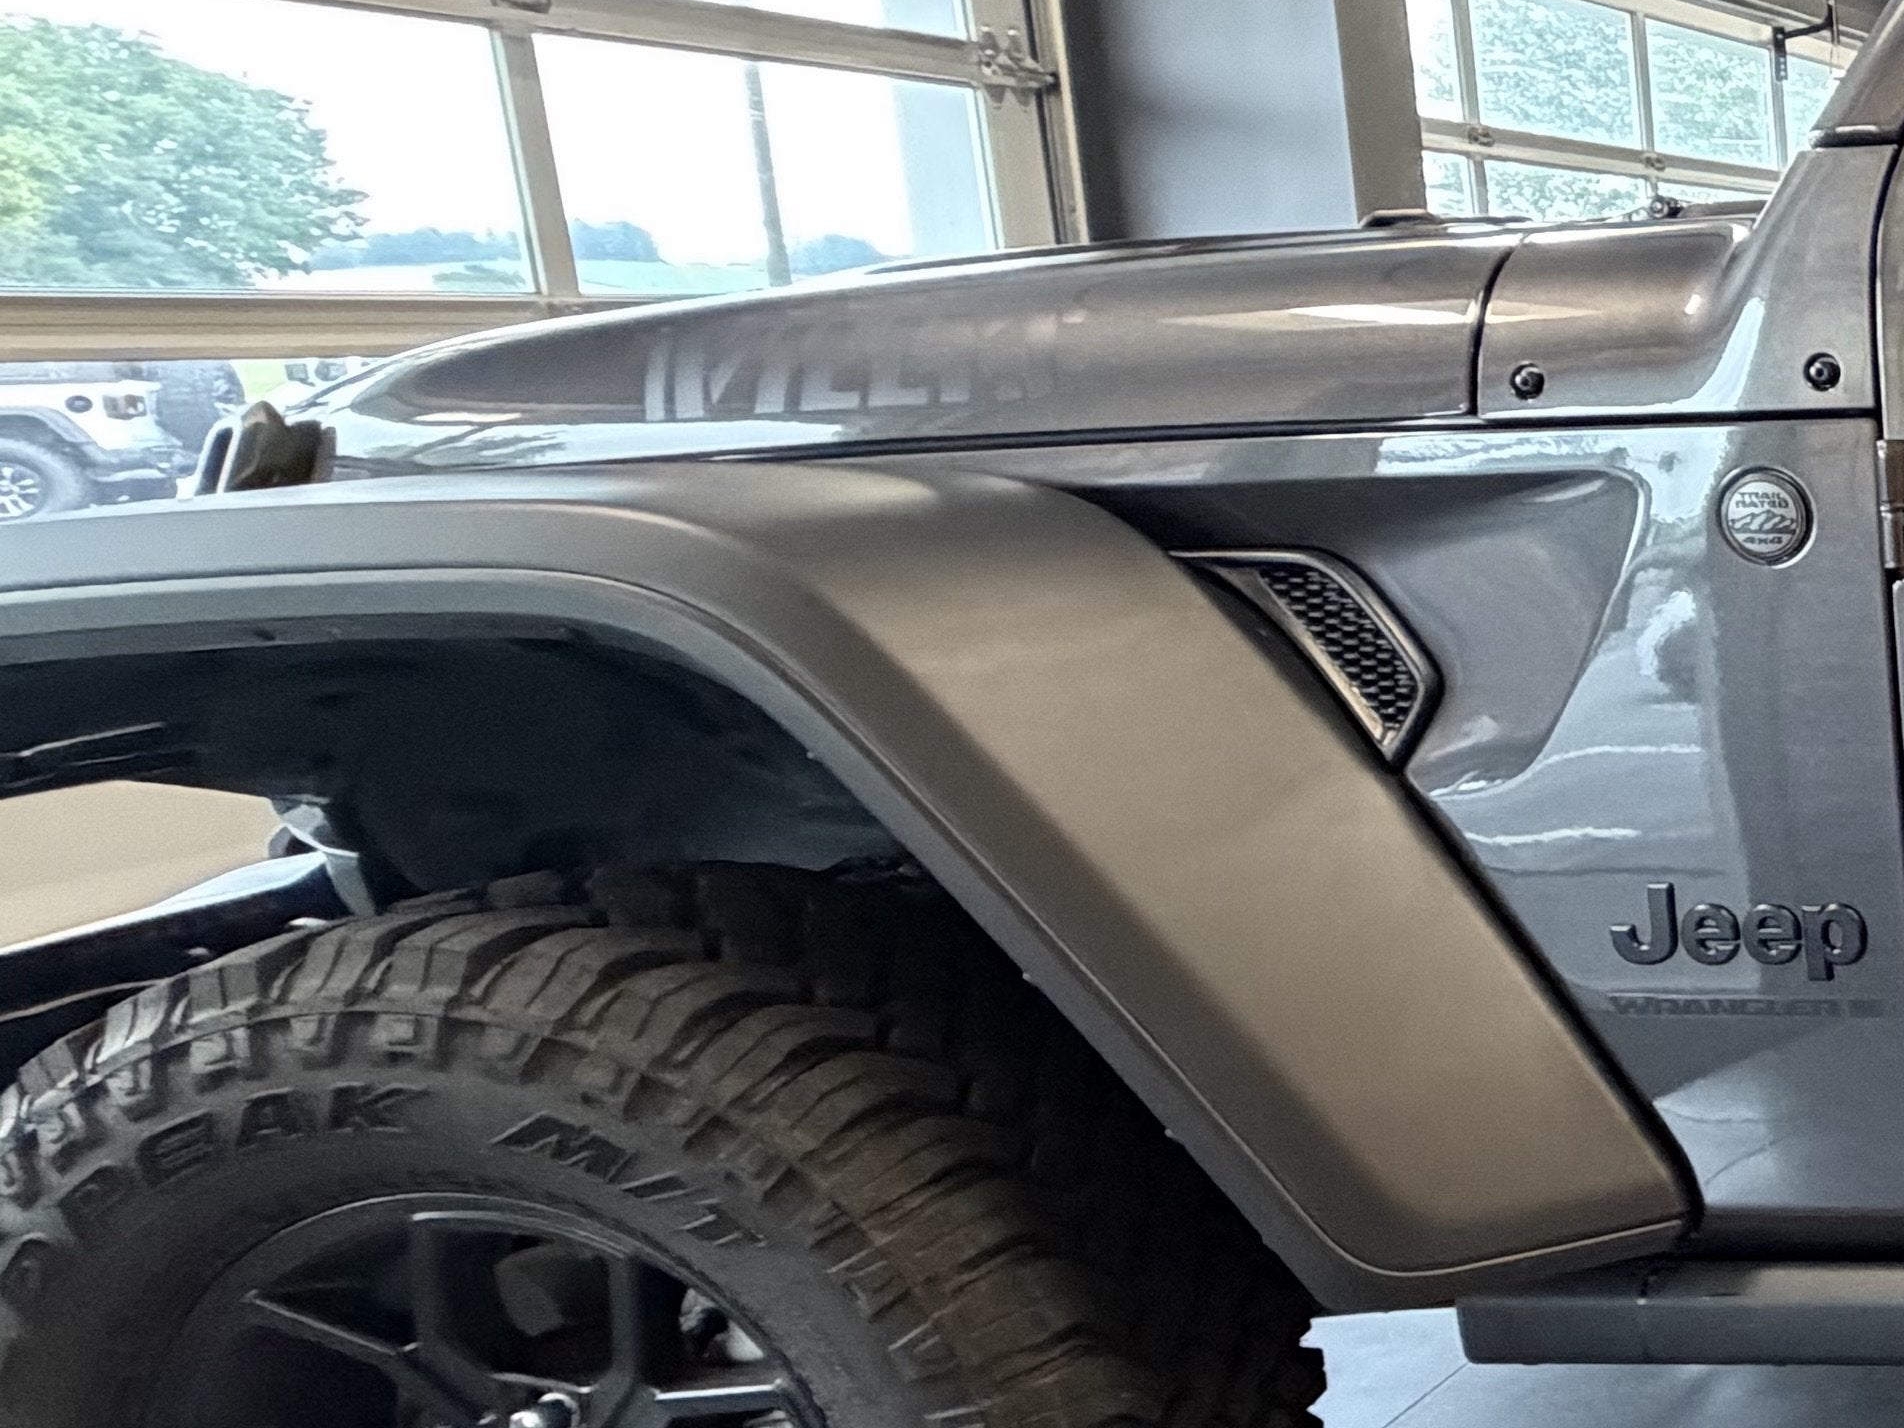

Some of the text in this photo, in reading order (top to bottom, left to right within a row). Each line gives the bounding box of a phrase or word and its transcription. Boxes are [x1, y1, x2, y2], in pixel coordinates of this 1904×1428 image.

[1735, 499, 1789, 509] RATED
[1738, 491, 1783, 499] TRAIL
[1609, 881, 1869, 982] Jeep
[488, 1110, 768, 1248] M/T
